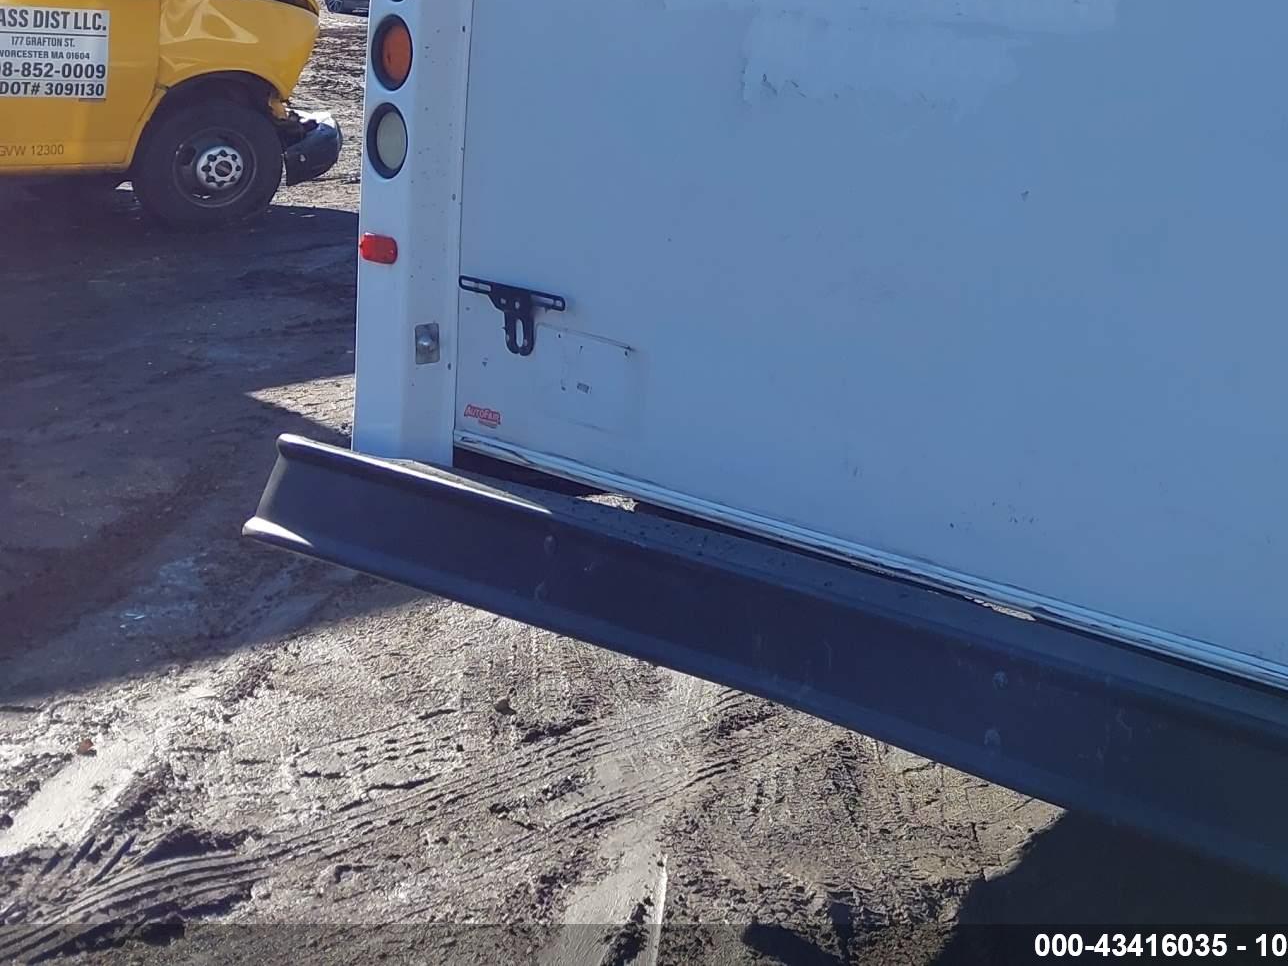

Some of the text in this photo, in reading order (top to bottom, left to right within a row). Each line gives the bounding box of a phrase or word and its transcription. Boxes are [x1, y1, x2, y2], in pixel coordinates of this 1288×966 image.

[33, 9, 70, 30] DIST
[73, 11, 107, 31] LLC.
[11, 36, 76, 48] 177 GRAFTON ST.
[51, 51, 64, 60] MA
[66, 52, 90, 60] 01604
[0, 61, 106, 79] 8-852-0009
[44, 83, 104, 97] 3091130
[0, 144, 64, 156] GVW 12300
